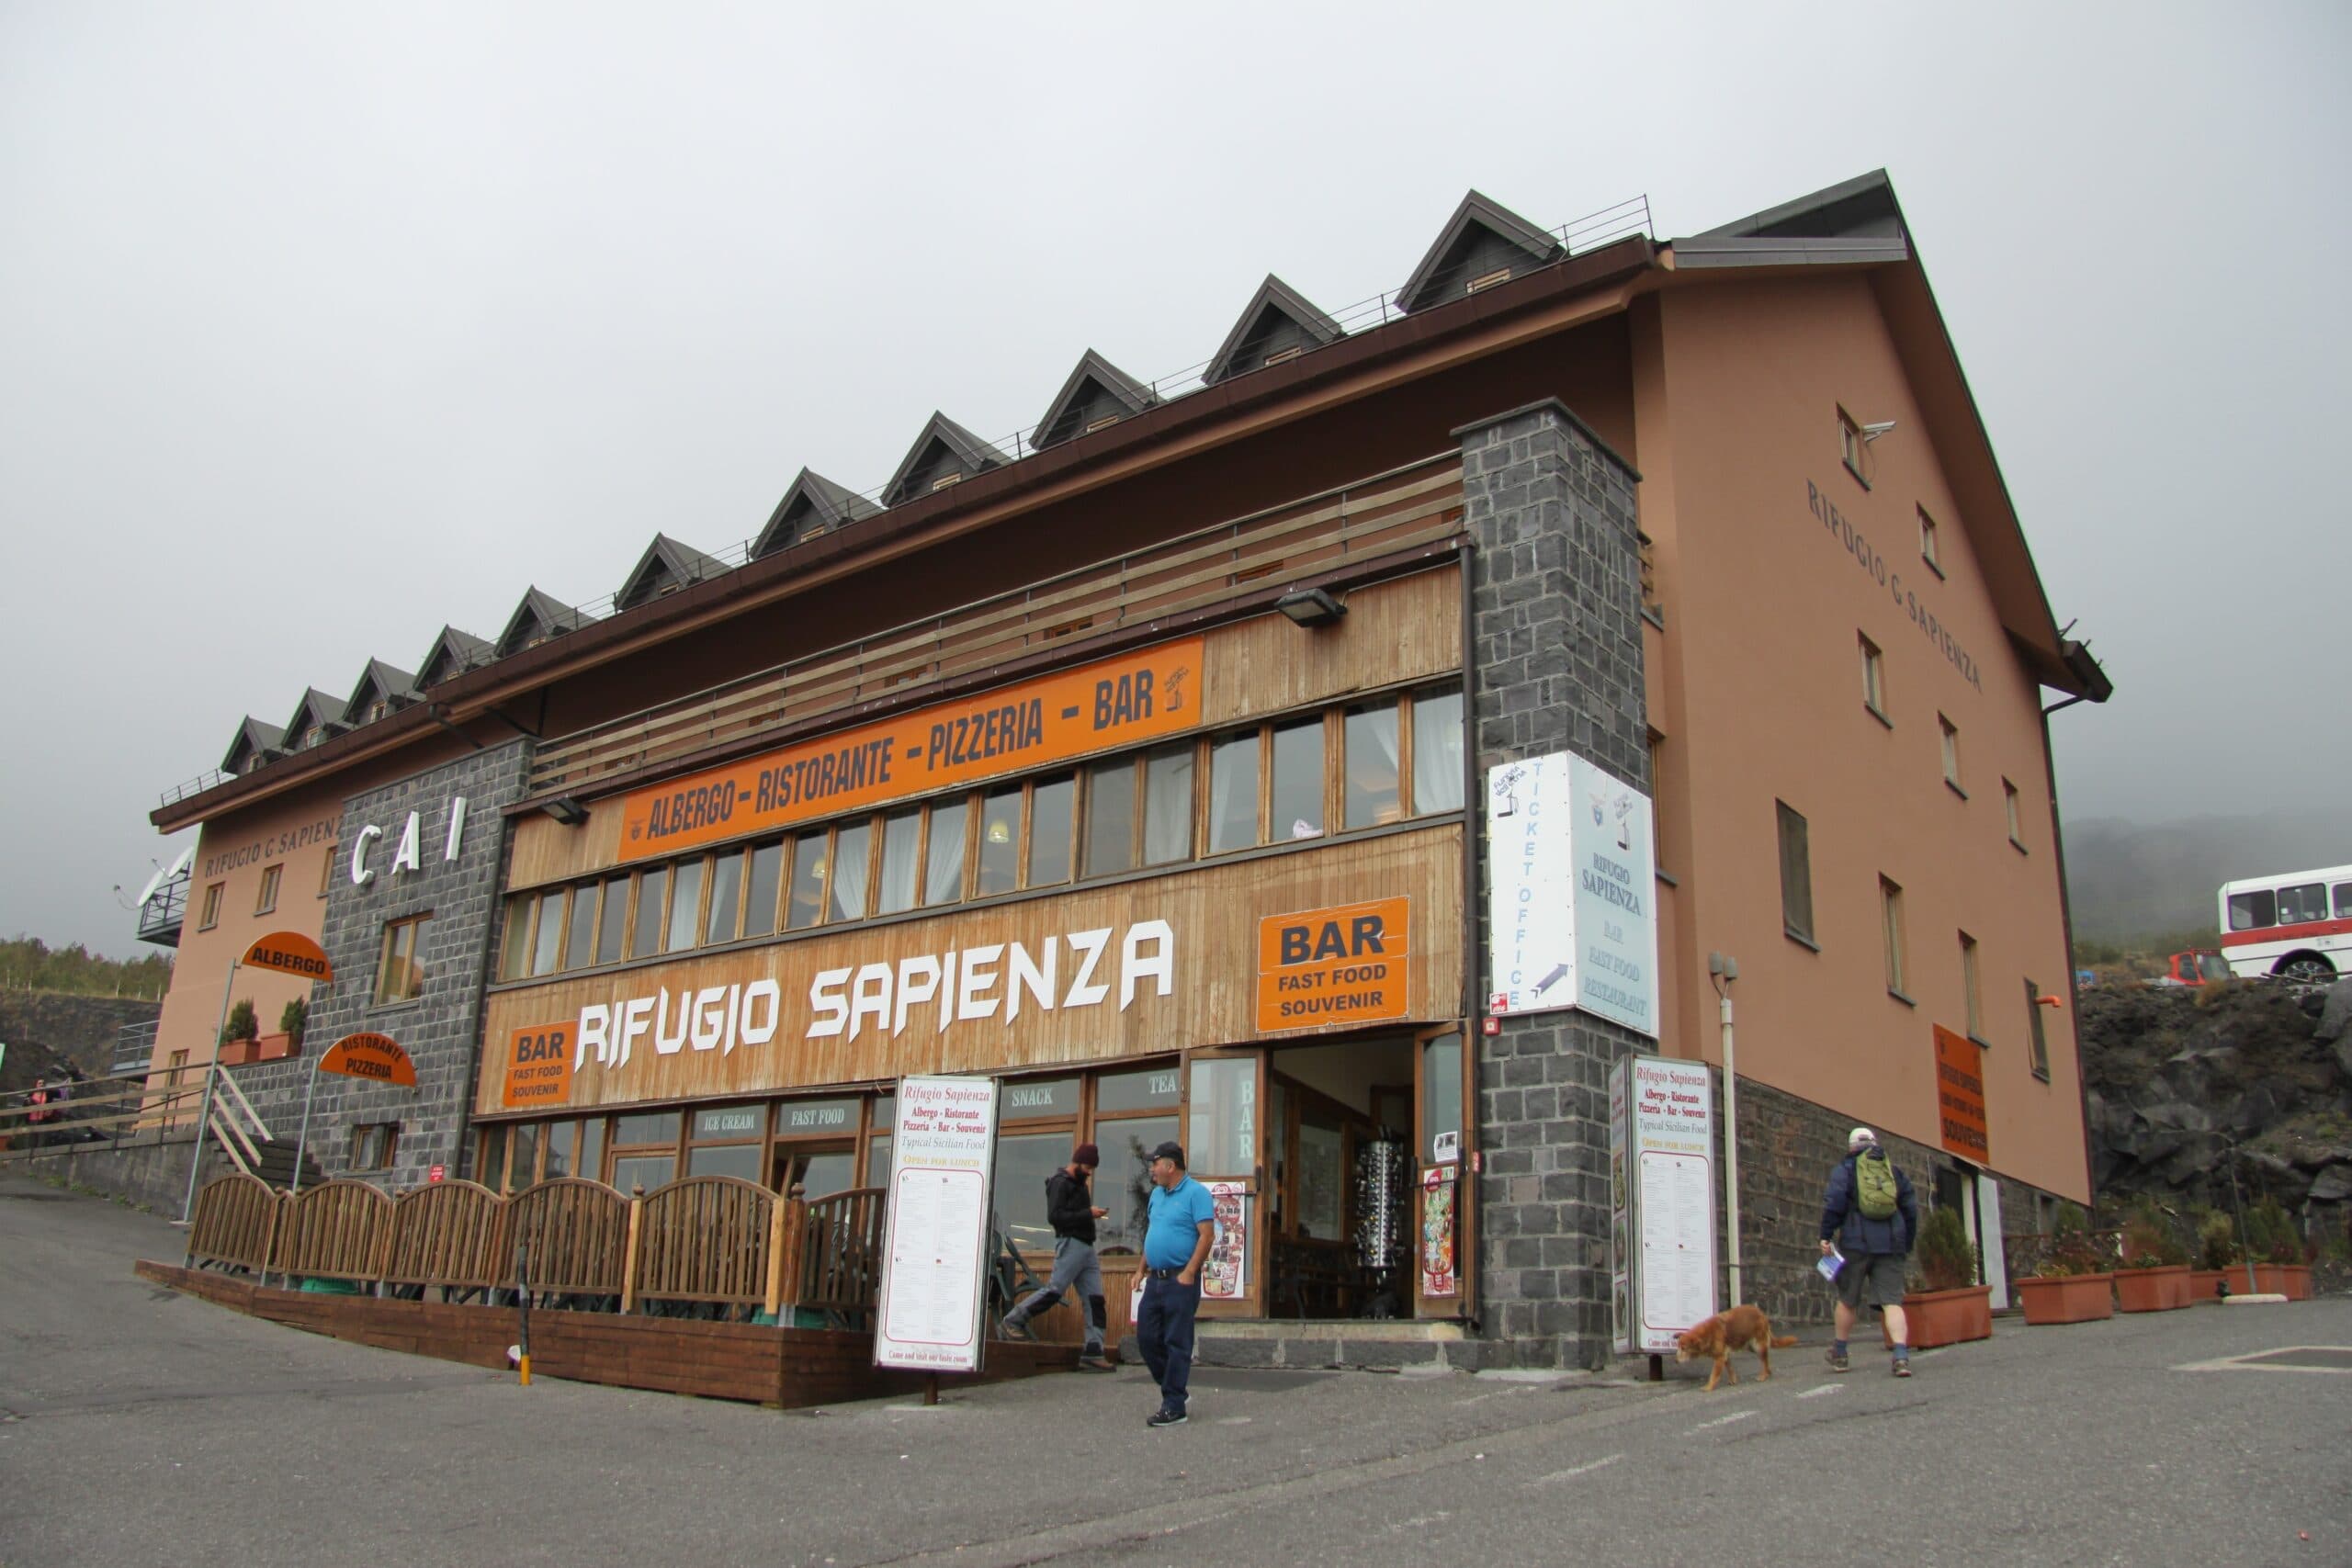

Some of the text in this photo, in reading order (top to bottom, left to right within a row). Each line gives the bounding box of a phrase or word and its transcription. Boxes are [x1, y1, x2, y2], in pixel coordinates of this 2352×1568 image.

[1806, 478, 1884, 587] RIFUGIO
[1907, 592, 1982, 694] SAPIENZA
[647, 780, 735, 840] ALBERGO
[755, 737, 895, 814] RISTORANTE
[928, 698, 1043, 772] PIZZERIA
[1093, 669, 1154, 731] BAR
[353, 796, 467, 885] CAI
[205, 843, 260, 879] RIFUGIO
[1593, 852, 1630, 885] RIFUGIO
[1510, 762, 1544, 1006] TICKET OFFICE
[1582, 868, 1642, 917] SAPIENZA
[1281, 915, 1384, 965] BAR
[252, 947, 325, 975] ALBERGO
[1589, 945, 1640, 982] FAST FOOD
[1279, 964, 1386, 991] FAST FOOD
[574, 919, 1173, 1073] RIFUGIO SAPIENZA
[1281, 991, 1383, 1016] SOUVENIR
[341, 1036, 403, 1063] RISTORANTE
[516, 1032, 564, 1063] BAR
[345, 1058, 391, 1078] PIZZERIA
[514, 1065, 562, 1080] FAST FOOD
[1636, 1066, 1668, 1086] Rifugio
[1669, 1070, 1706, 1088] Sapienza
[513, 1084, 559, 1098] SOUVENIR
[904, 1086, 990, 1103] Rifugio Sapienza
[1149, 1074, 1177, 1094] TEA
[1645, 1088, 1700, 1104] Albergo Ristorante
[1012, 1088, 1053, 1107] SNACK
[1639, 1102, 1706, 1118] Pizzeria Bar Souvenir
[704, 1114, 754, 1131] ICE CREAM
[791, 1108, 844, 1126] FAST FOOD
[911, 1106, 979, 1120] Albergo Ristorante
[1240, 1080, 1253, 1159] BAR
[903, 1121, 986, 1134] Pizzeria Bar Souvenir
[1639, 1118, 1707, 1134] Typical Sicilian Food
[901, 1135, 986, 1150] Typical Sicilian Food
